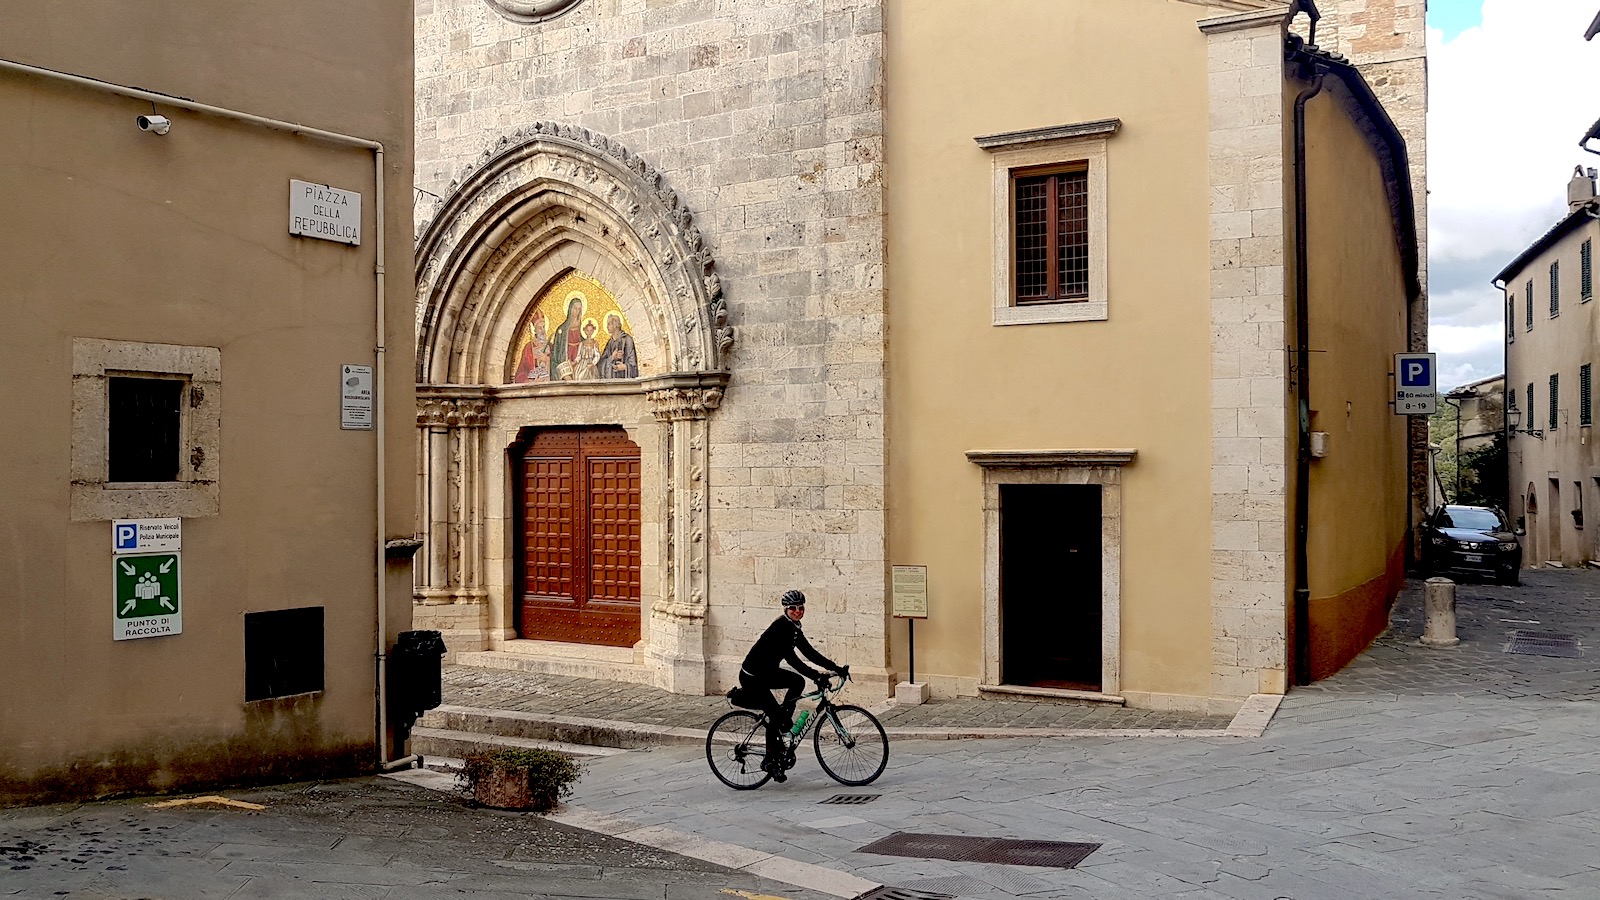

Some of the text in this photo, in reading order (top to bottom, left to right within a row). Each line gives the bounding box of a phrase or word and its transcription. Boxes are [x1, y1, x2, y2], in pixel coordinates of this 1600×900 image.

[305, 187, 348, 206] PIAZZA
[313, 204, 341, 219] DELLA
[294, 216, 358, 240] REPUBBLICA
[1408, 363, 1423, 382] P
[118, 526, 135, 547] P
[155, 532, 179, 540] Municipale
[127, 617, 170, 628] PUNTO DI
[125, 626, 171, 637] RACCOLTA
